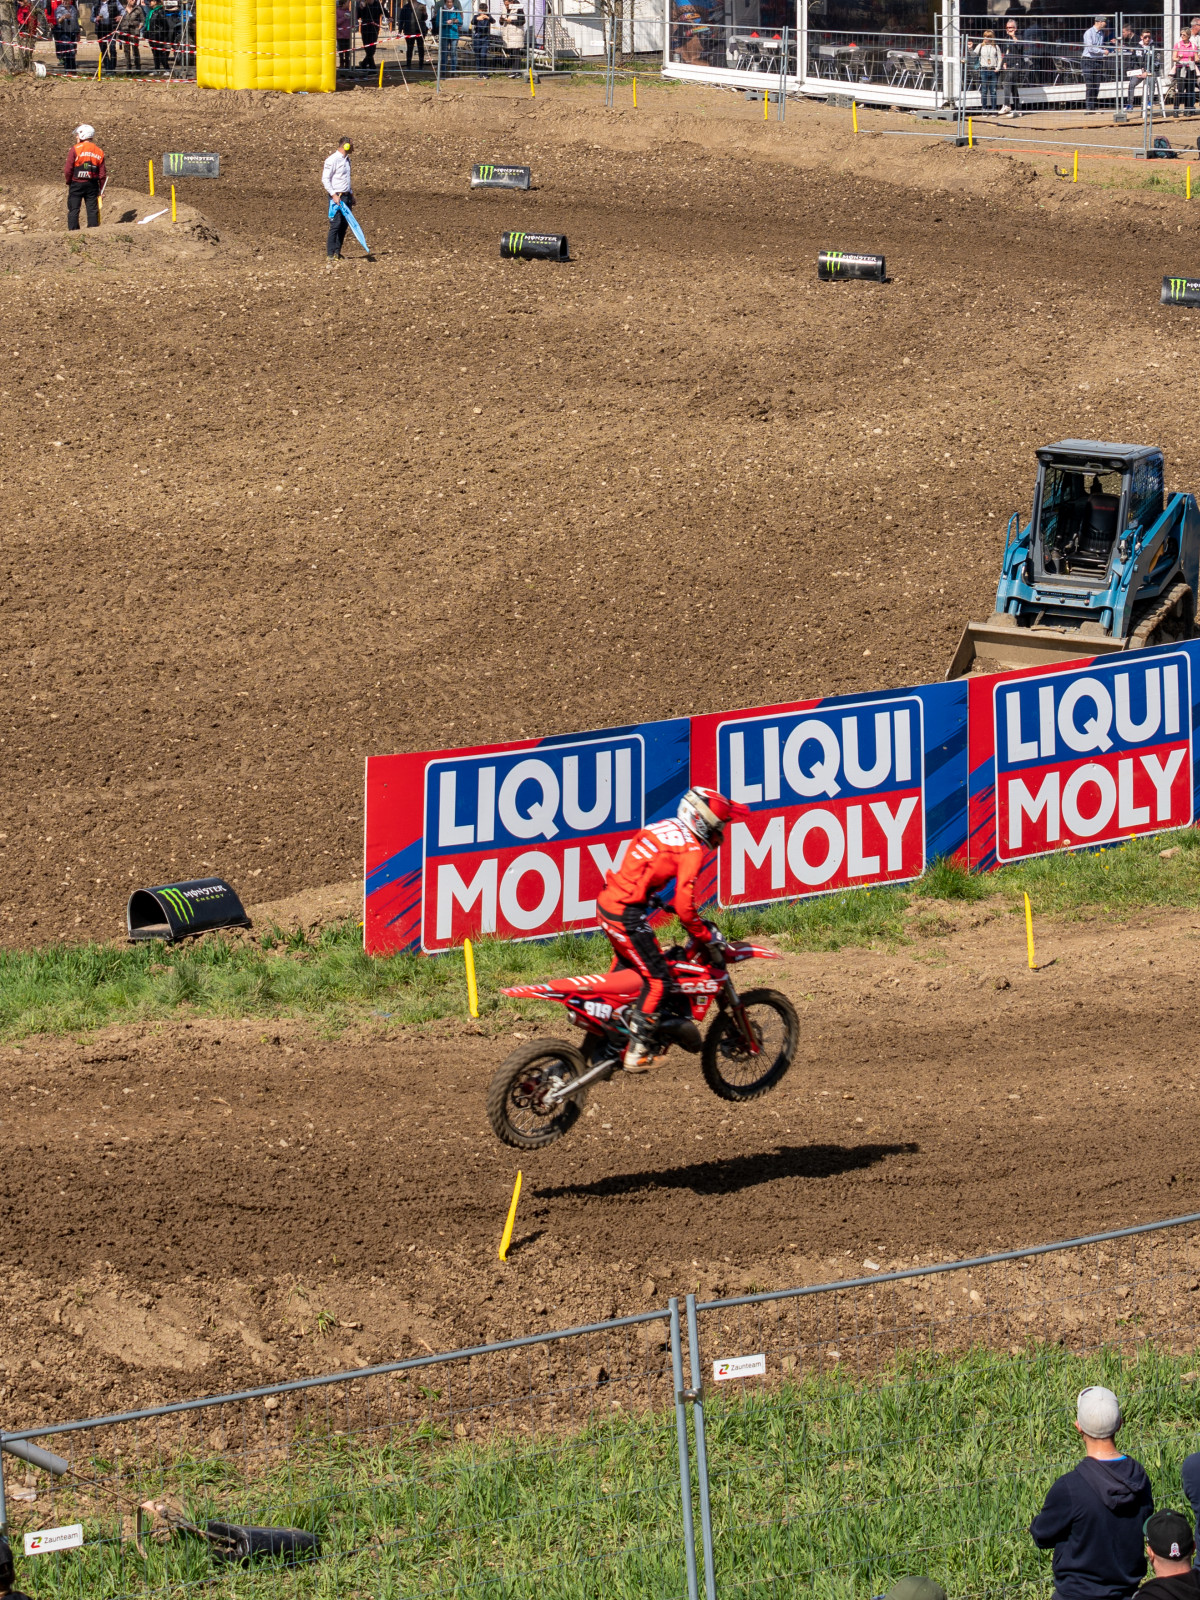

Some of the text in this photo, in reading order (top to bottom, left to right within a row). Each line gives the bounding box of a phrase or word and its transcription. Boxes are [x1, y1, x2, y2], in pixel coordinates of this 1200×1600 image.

[729, 709, 912, 804] LIQUI
[1006, 664, 1180, 763] LIQUI
[438, 748, 632, 847] LIQUI
[730, 796, 919, 896] MOLY
[1008, 748, 1187, 850] MOLY
[183, 885, 227, 898] MONSTER
[436, 839, 633, 940] MOLY
[584, 1001, 612, 1020] 919
[731, 1362, 761, 1371] Zaunteam
[44, 1533, 78, 1543] Zaunteam
